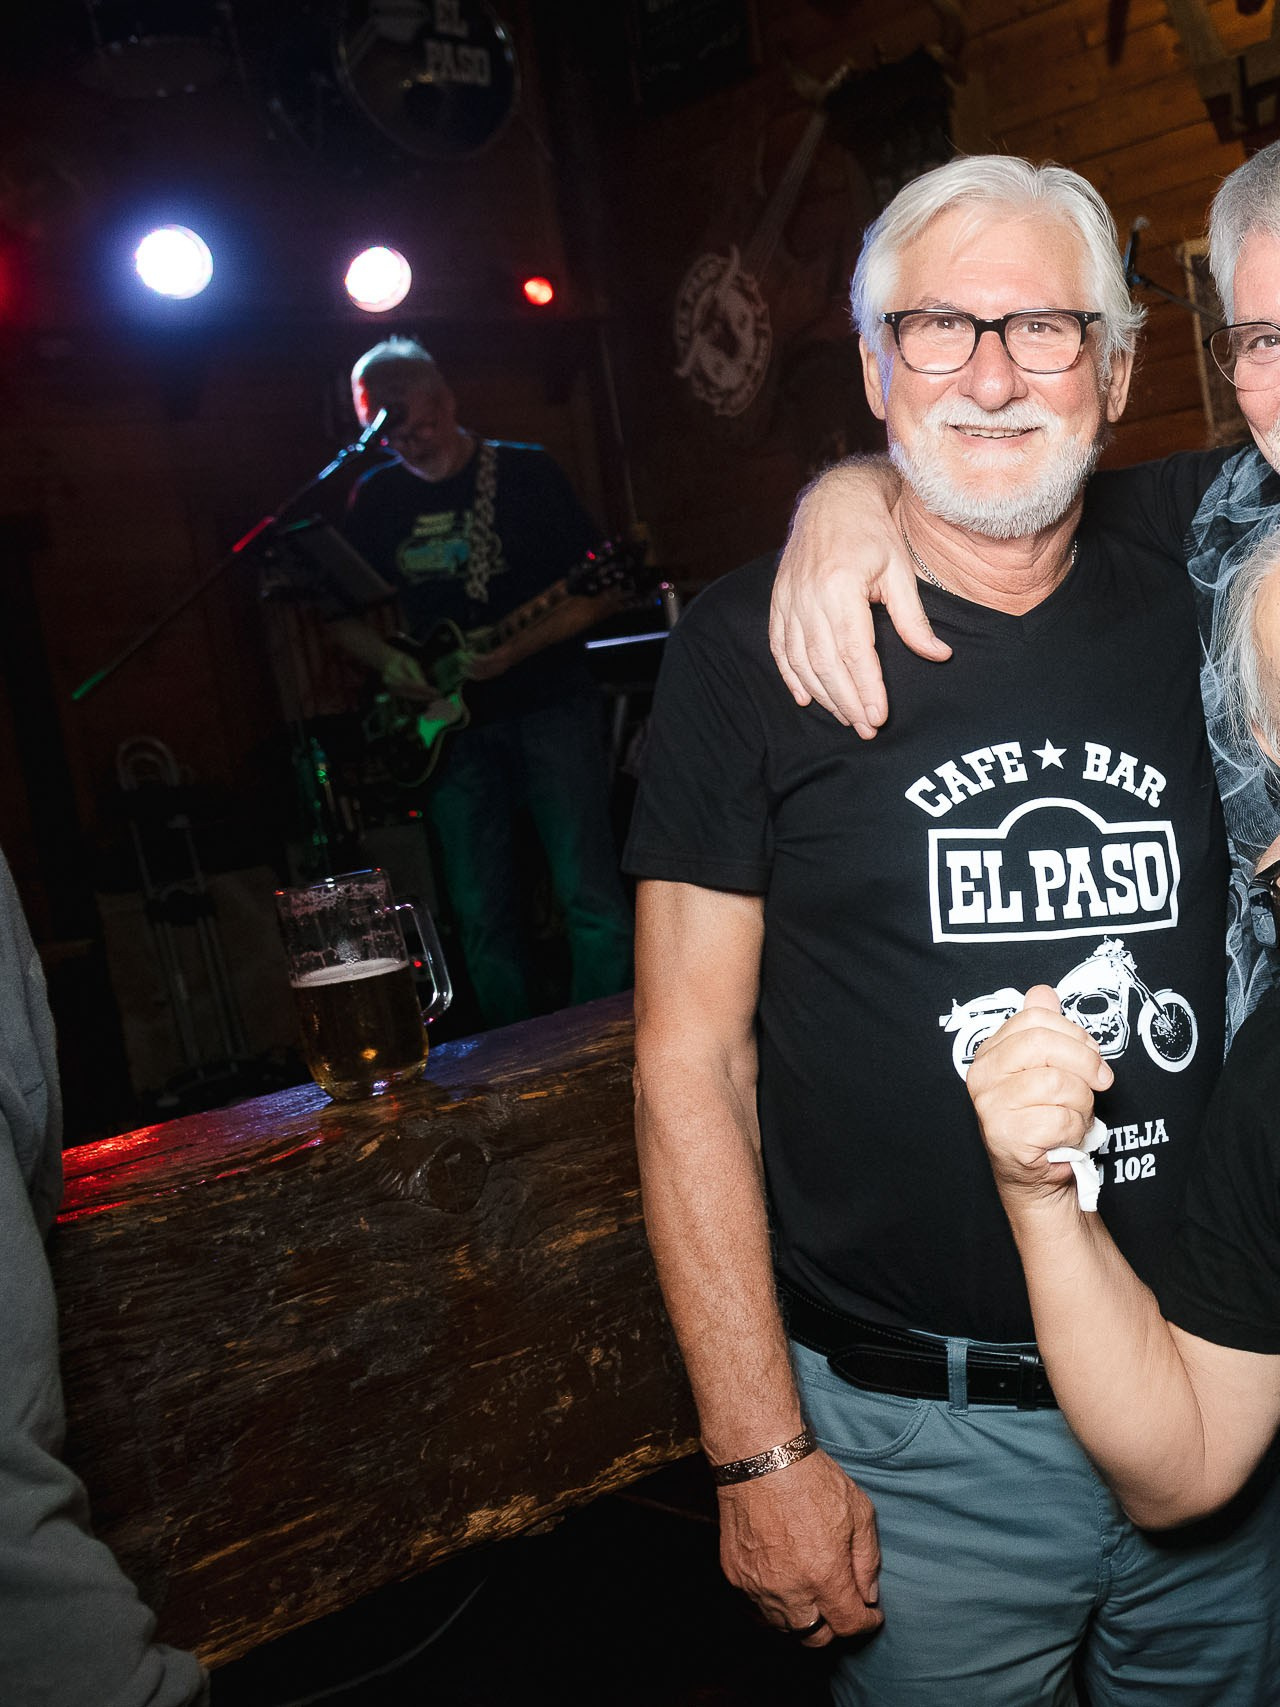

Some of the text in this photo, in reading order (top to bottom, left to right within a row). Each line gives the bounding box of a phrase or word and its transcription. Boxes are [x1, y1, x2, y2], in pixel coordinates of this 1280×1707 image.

[423, 37, 492, 87] PASO
[904, 741, 1167, 818] CAFE BAR
[946, 841, 1170, 925] EL PASO
[1113, 1152, 1157, 1184] 102
